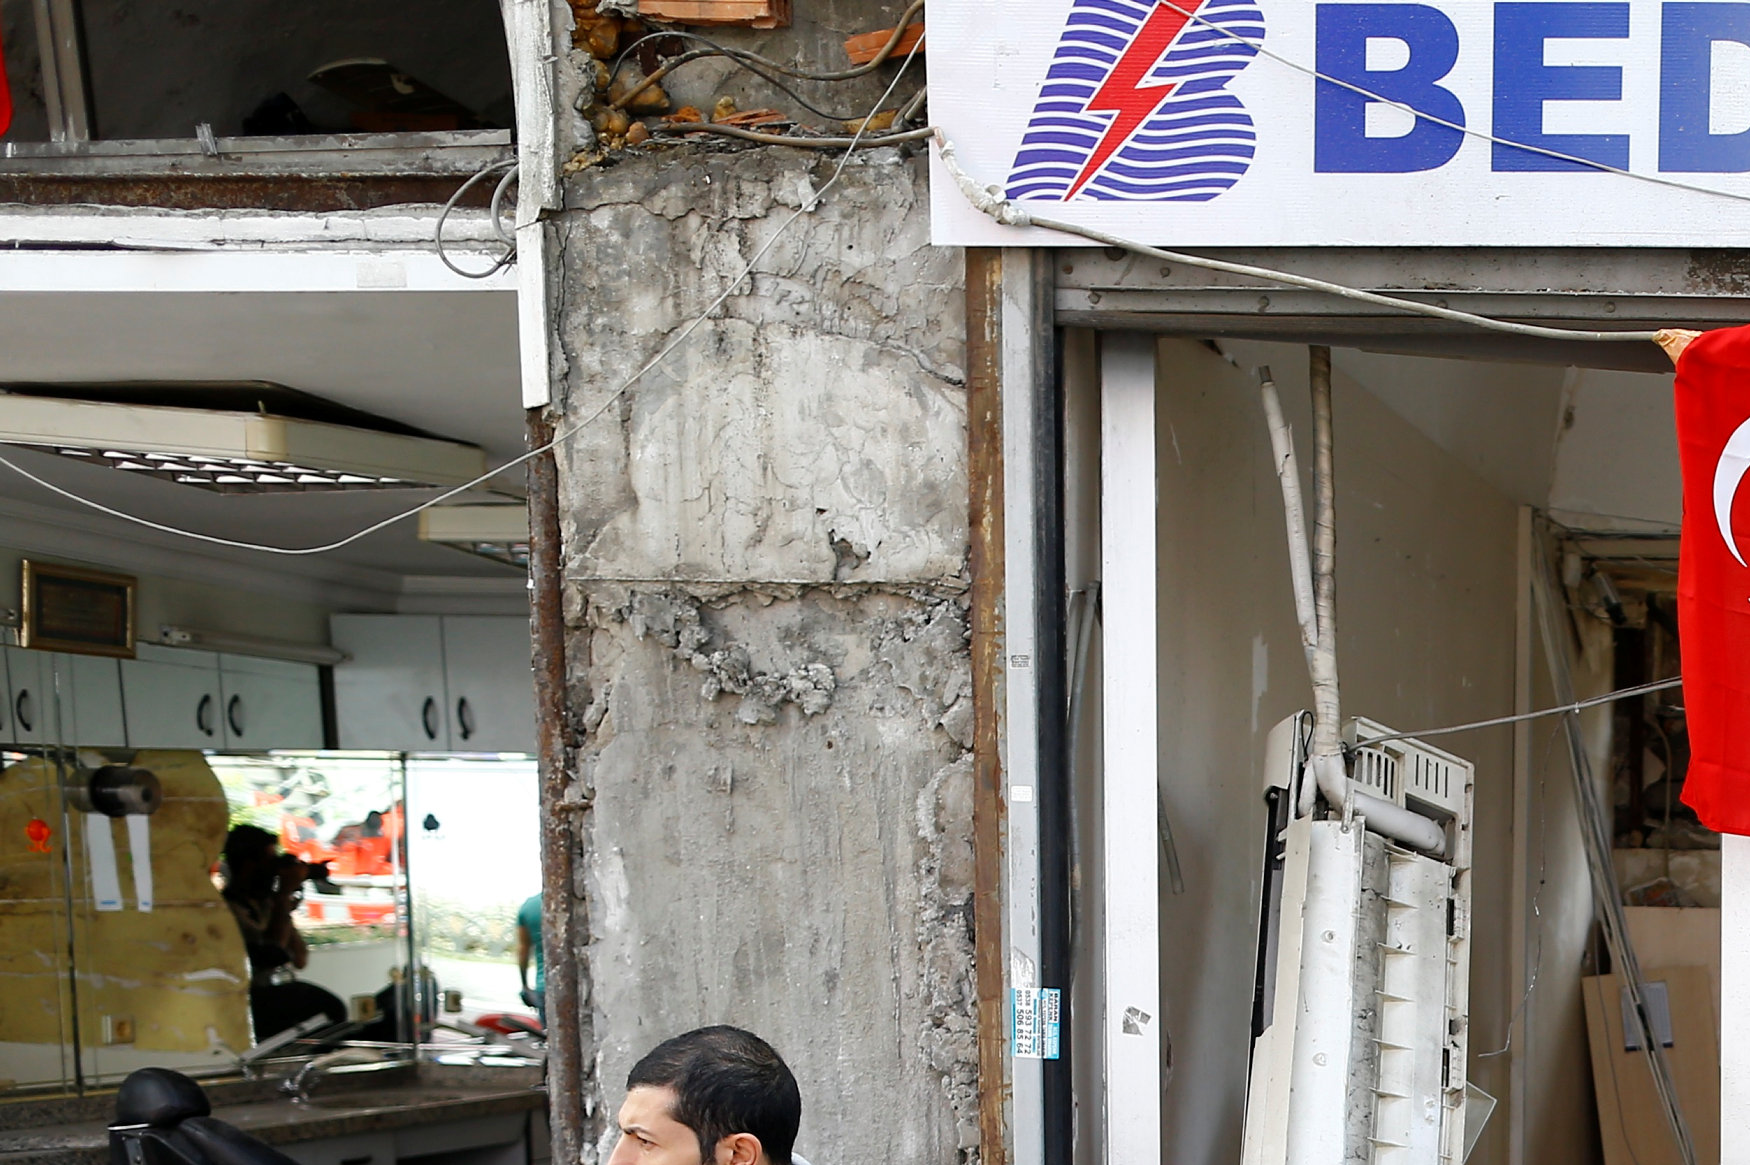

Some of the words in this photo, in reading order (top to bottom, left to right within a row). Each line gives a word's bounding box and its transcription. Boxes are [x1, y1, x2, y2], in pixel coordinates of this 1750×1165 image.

[1017, 1028, 1023, 1040] 85
[1025, 1029, 1031, 1040] 72
[1017, 1043, 1023, 1054] 64
[1025, 1043, 1031, 1054] 72
